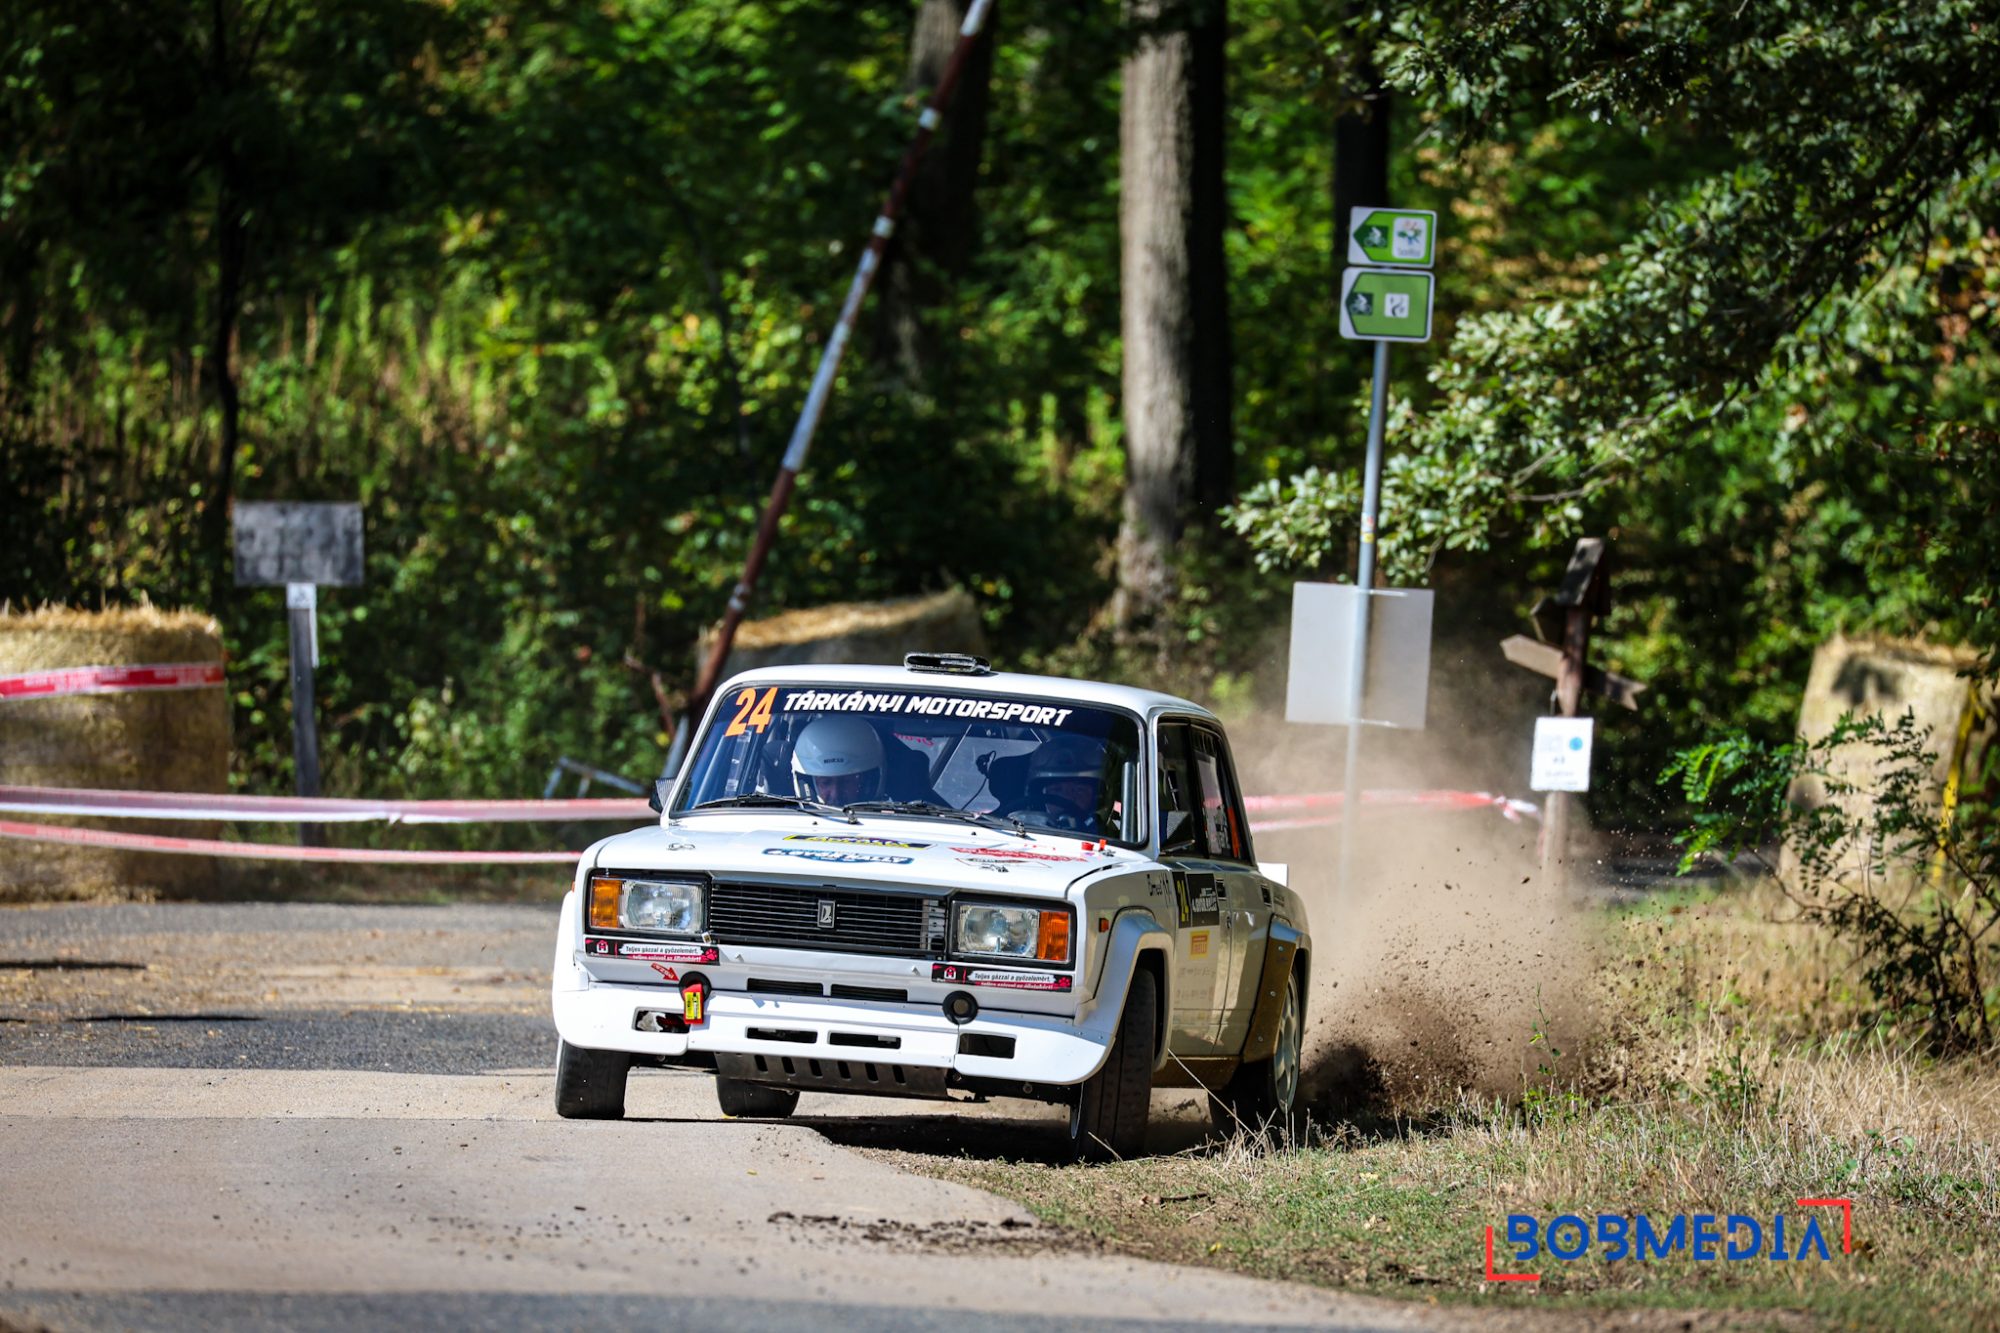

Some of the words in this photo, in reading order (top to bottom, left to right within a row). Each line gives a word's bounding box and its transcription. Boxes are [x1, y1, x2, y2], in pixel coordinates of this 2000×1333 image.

[724, 686, 779, 737] 24
[783, 690, 904, 713] TÁRKÁNYI
[905, 695, 1073, 727] MOTORSPORT
